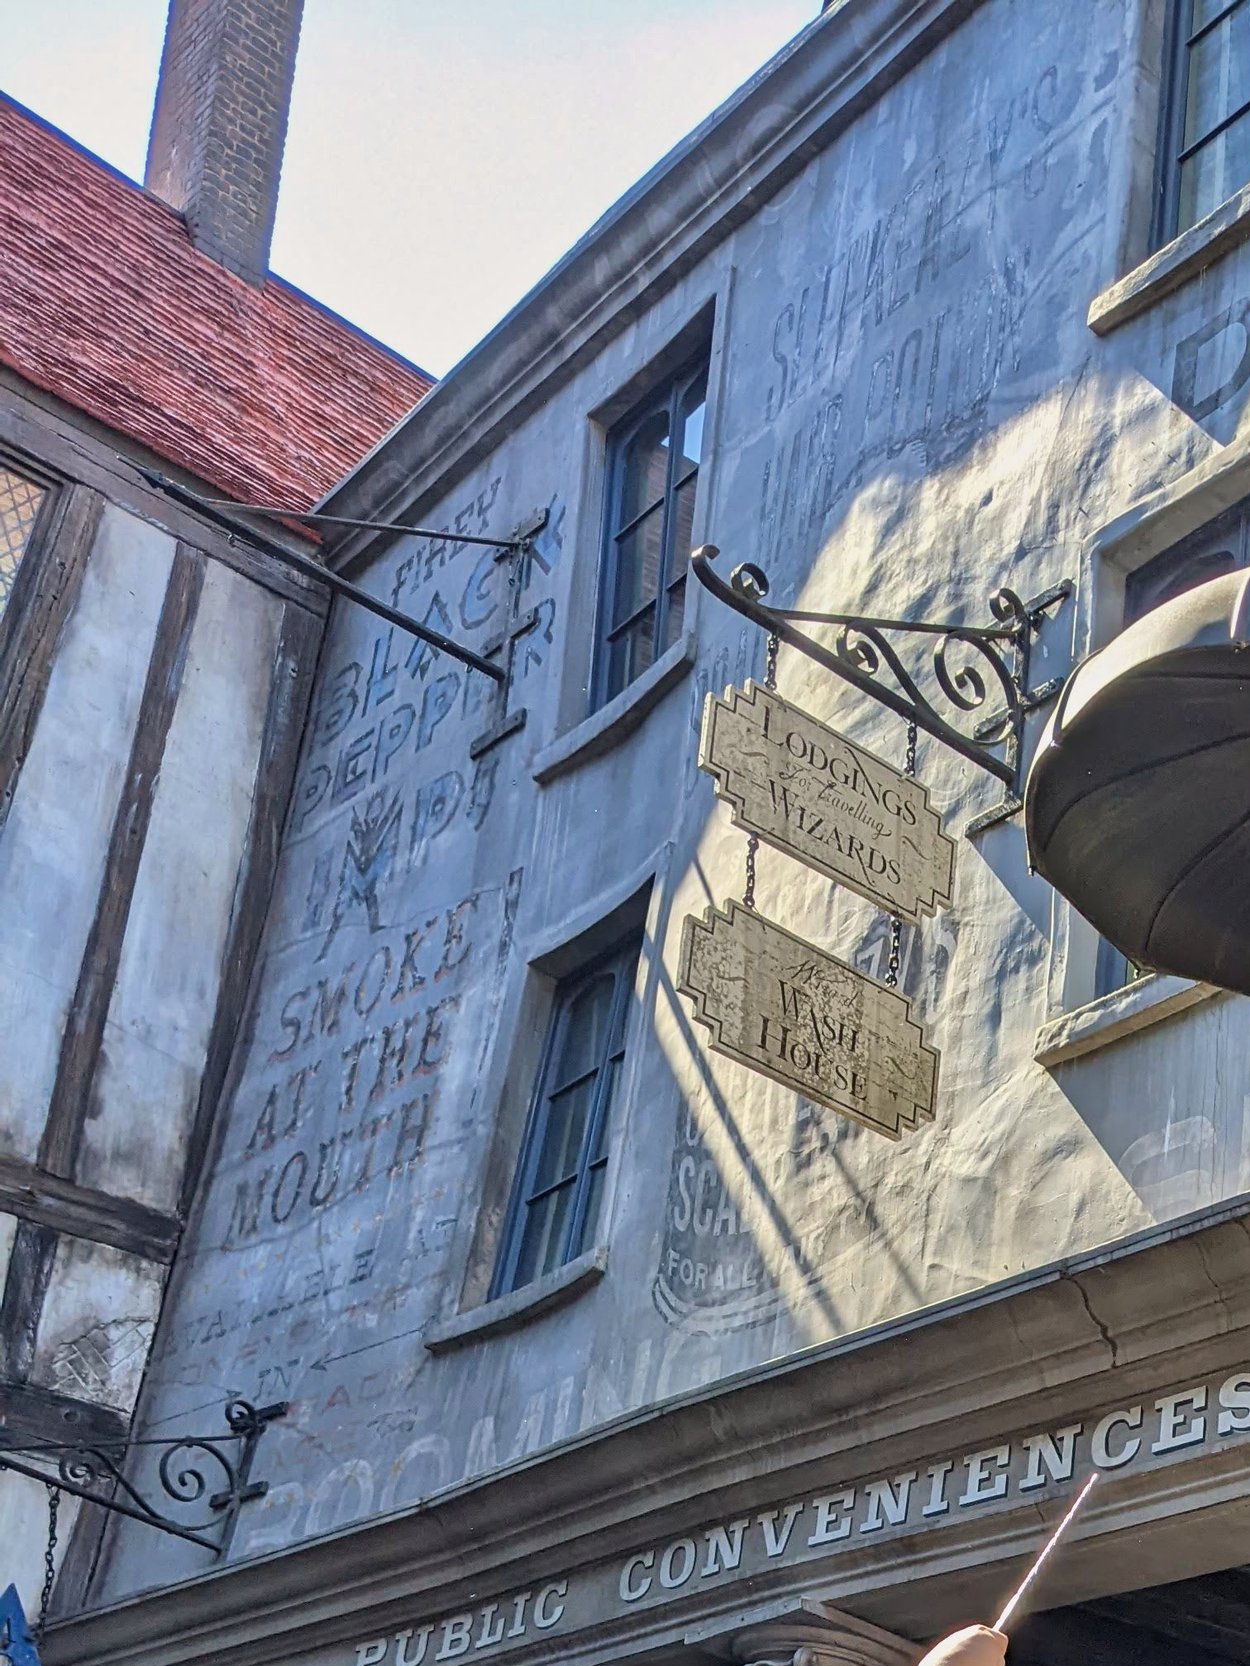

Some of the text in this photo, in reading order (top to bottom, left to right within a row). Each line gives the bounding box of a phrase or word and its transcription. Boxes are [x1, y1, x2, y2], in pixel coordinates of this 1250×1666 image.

[306, 492, 567, 758] BLACK
[762, 706, 917, 826] LODGINGS
[768, 779, 902, 886] WIZARDS
[267, 899, 480, 1063] SMOKE
[777, 978, 859, 1055] WASH
[245, 994, 463, 1158] AT THE
[757, 1013, 868, 1100] HOUSE
[222, 1092, 437, 1250] MOUTH
